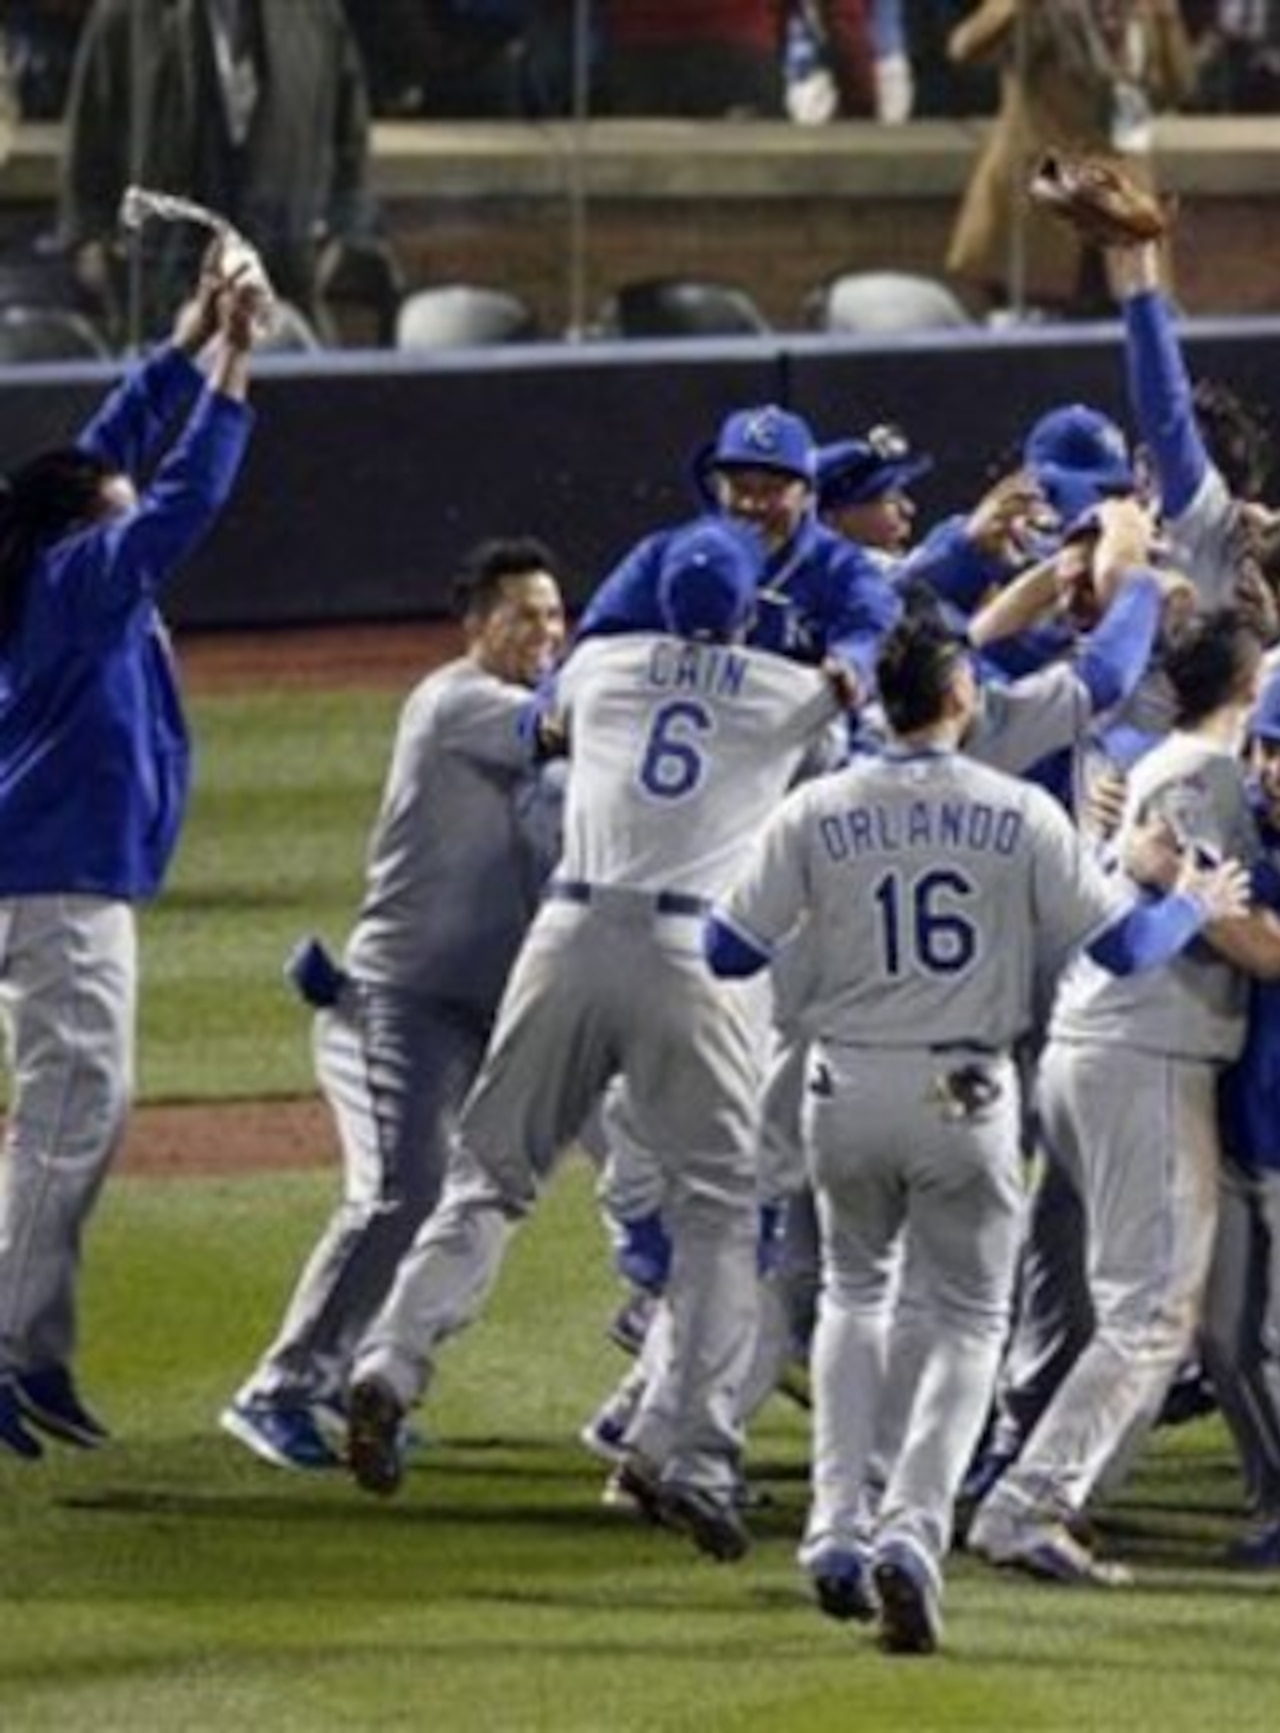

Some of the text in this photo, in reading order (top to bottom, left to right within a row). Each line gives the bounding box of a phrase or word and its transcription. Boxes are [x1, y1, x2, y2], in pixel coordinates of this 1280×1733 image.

[646, 645, 747, 697] CAIN
[641, 702, 709, 798] 6
[818, 804, 1022, 864] ORLANDO
[875, 868, 977, 978] 16
